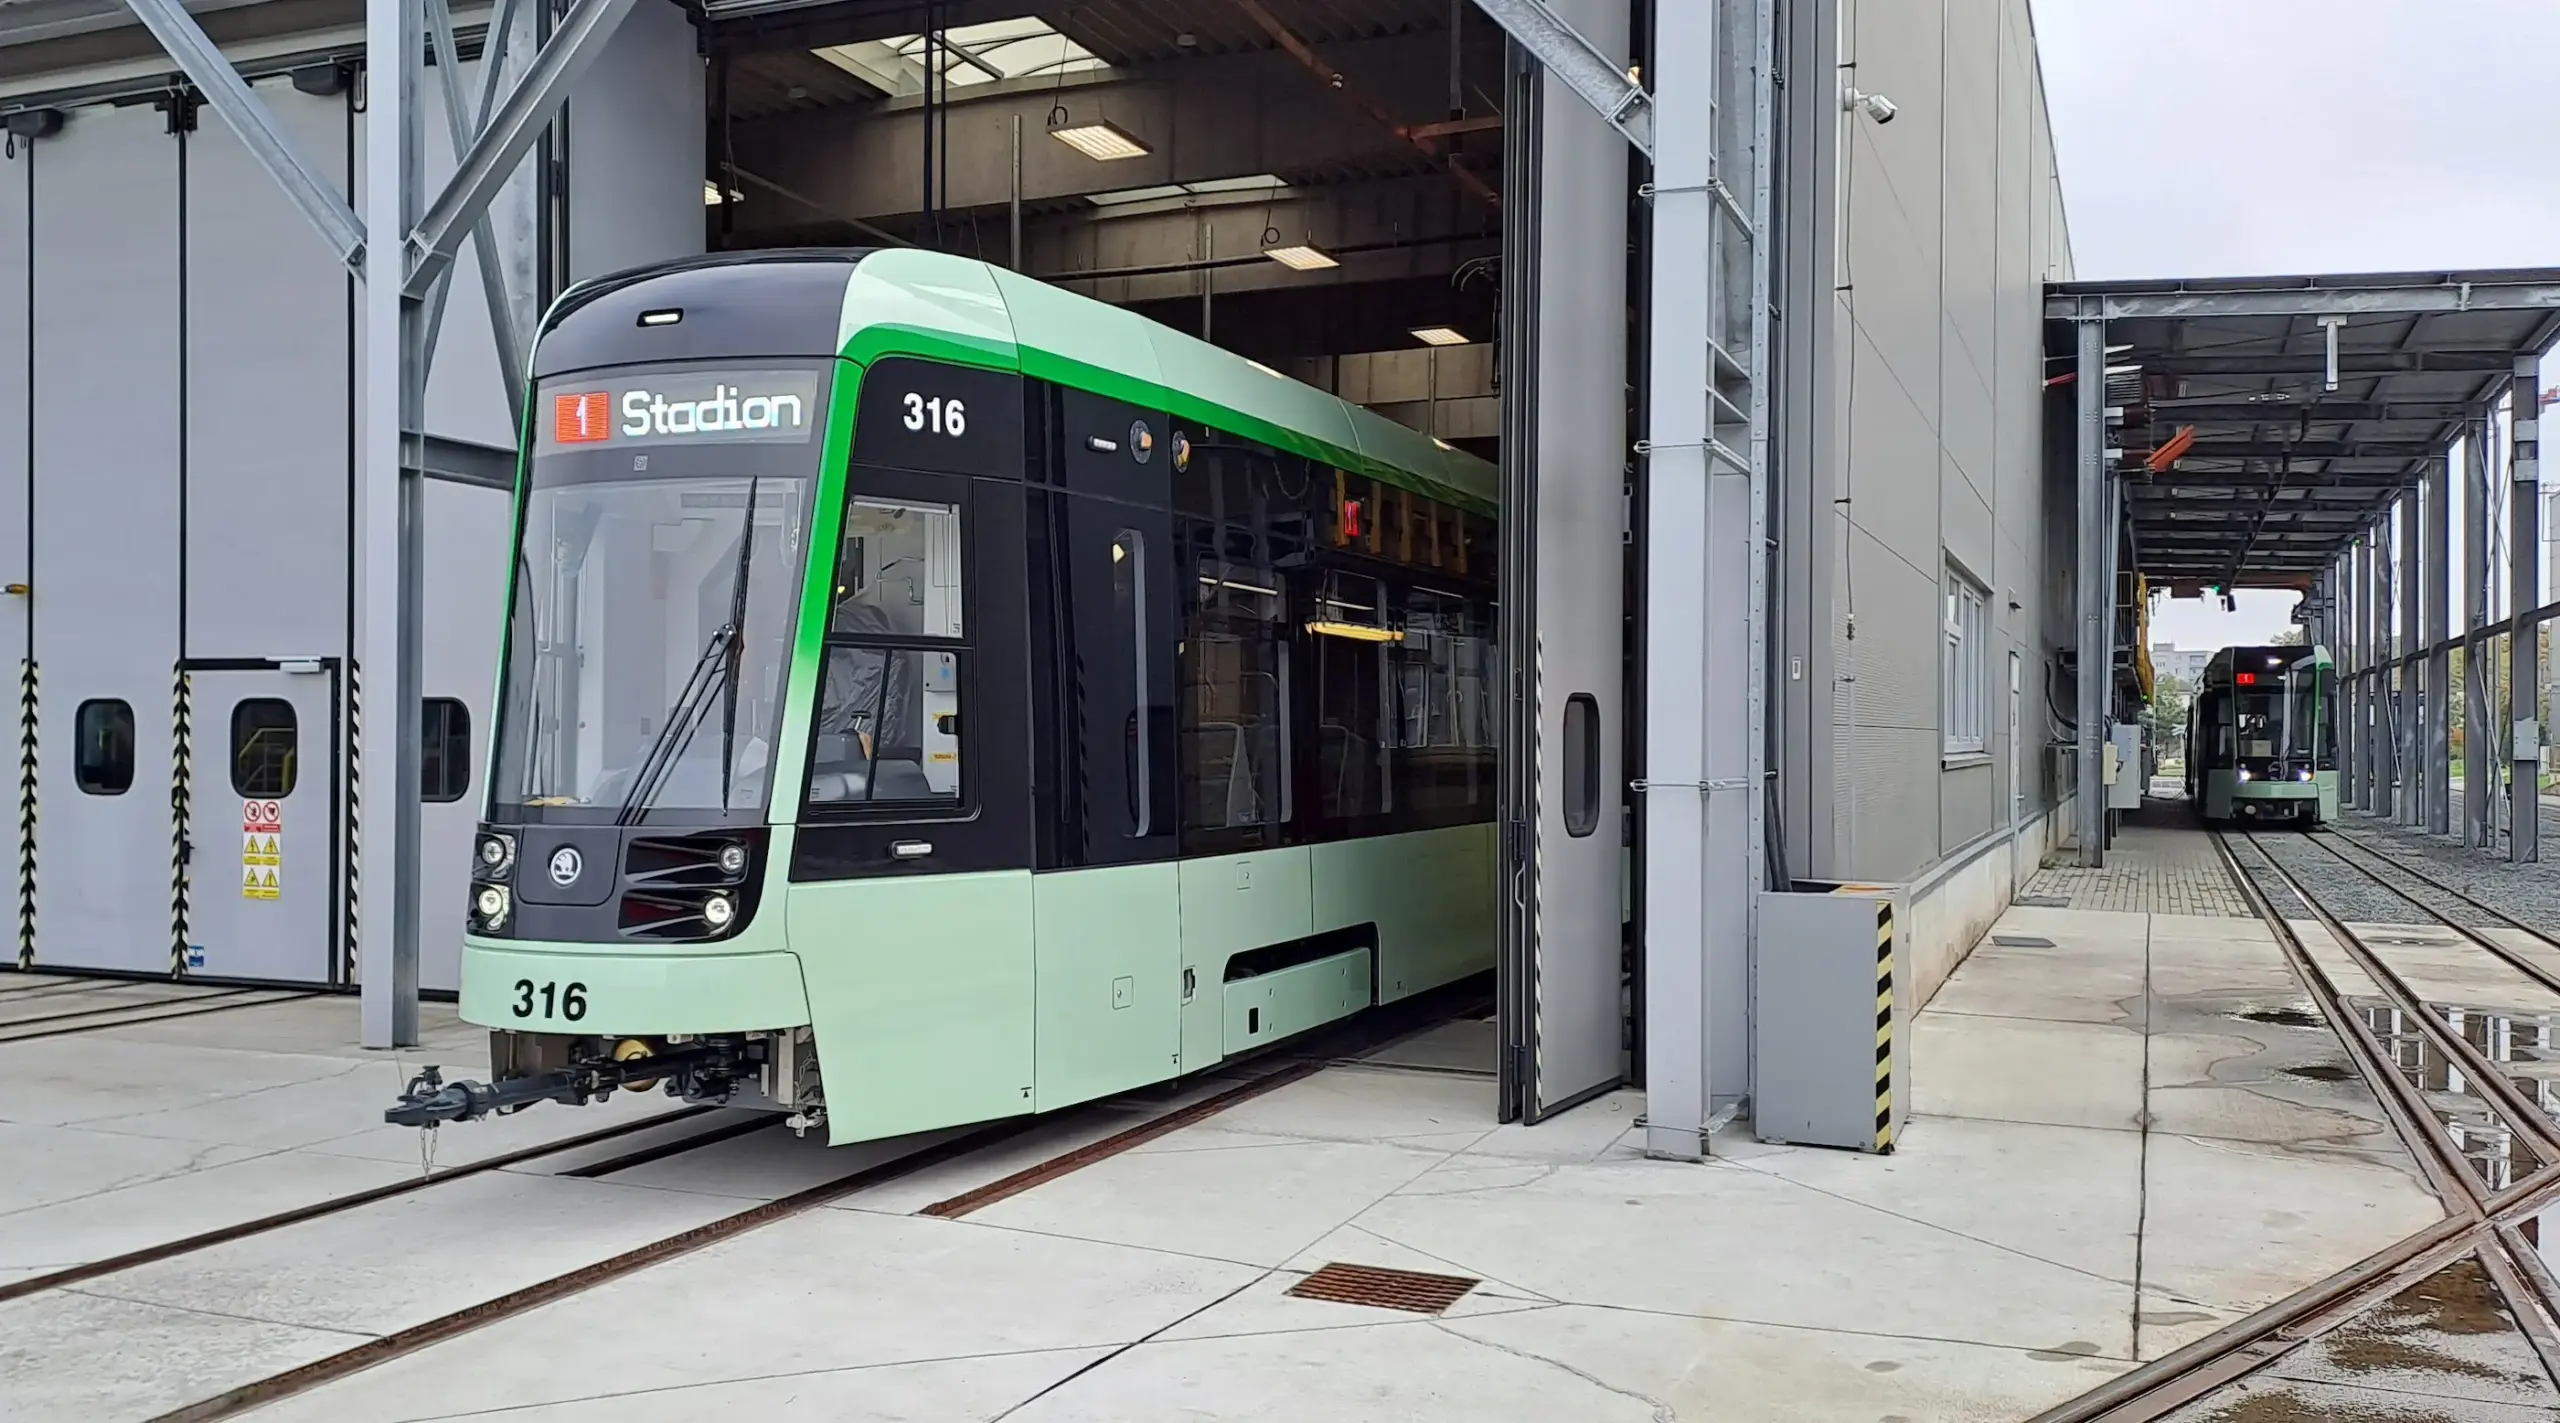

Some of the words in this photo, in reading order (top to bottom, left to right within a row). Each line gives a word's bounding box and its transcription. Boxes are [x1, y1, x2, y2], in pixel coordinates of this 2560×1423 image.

[576, 395, 587, 437] 1
[622, 384, 801, 437] Stadion
[903, 392, 966, 436] 316
[512, 979, 587, 1021] 316
